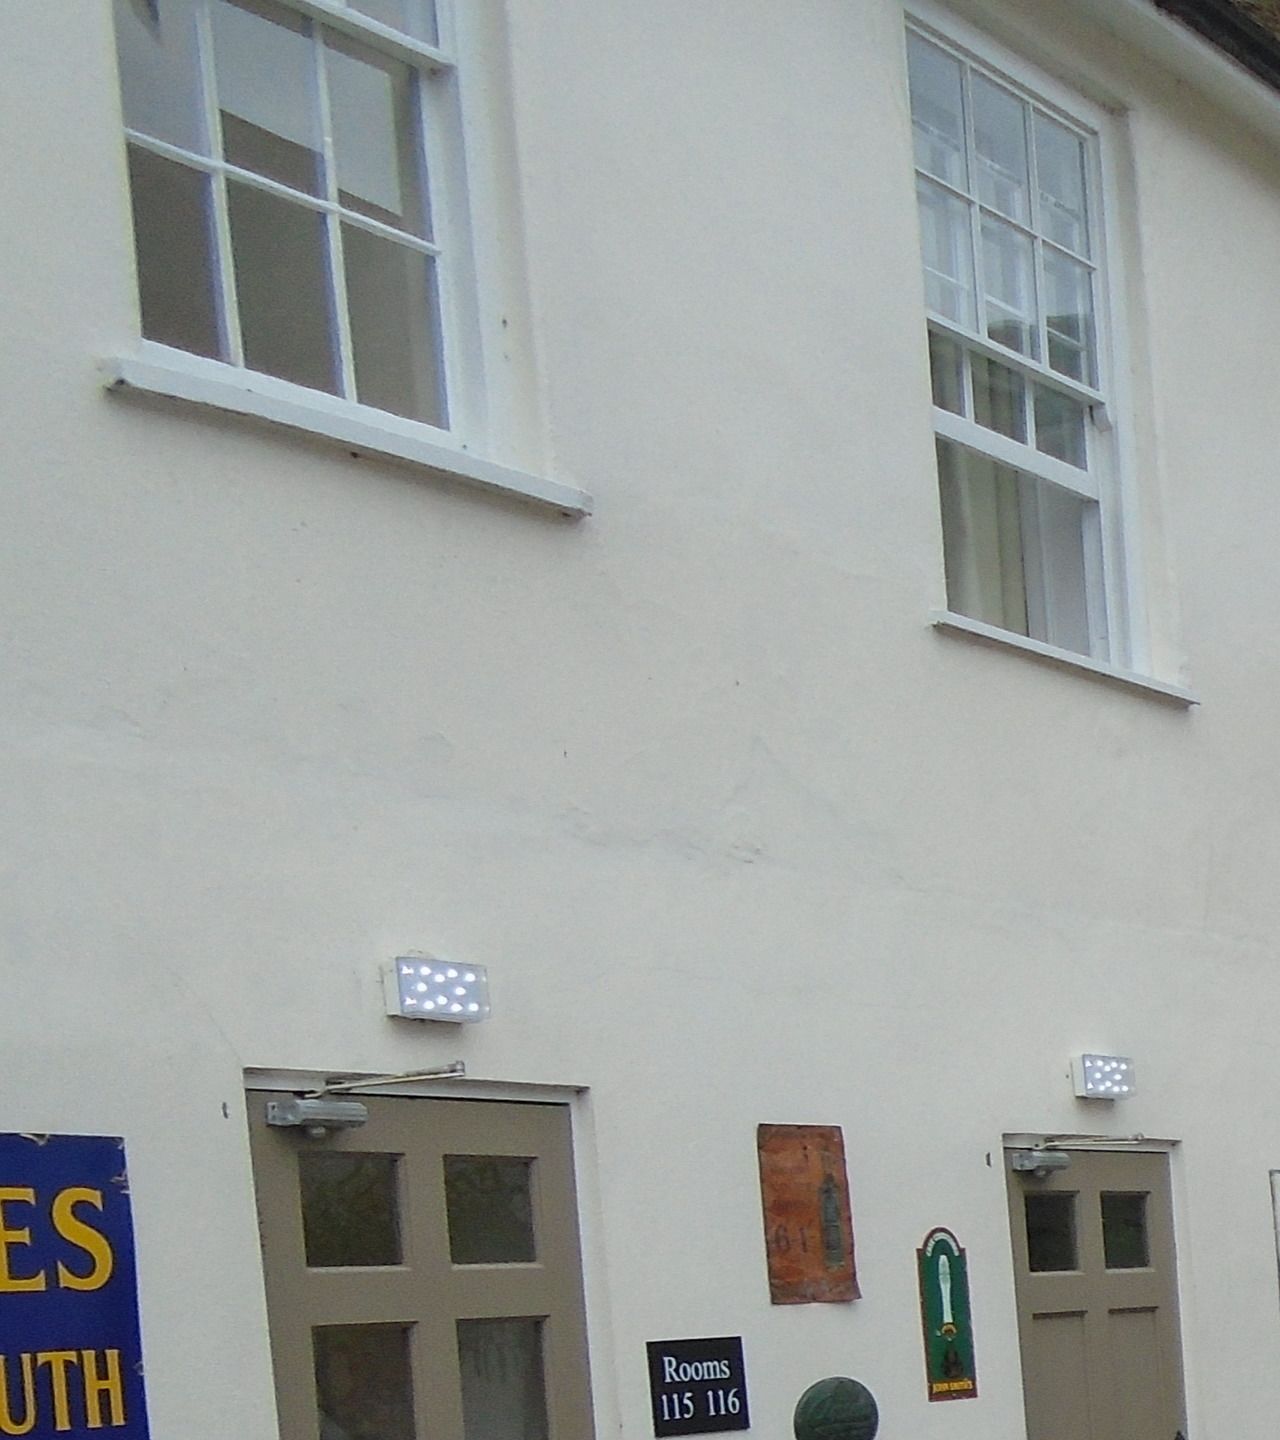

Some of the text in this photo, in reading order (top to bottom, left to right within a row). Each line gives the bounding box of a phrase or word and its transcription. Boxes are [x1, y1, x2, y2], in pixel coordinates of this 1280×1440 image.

[0, 1186, 114, 1292] ES
[0, 1349, 127, 1435] UTH
[662, 1356, 731, 1382] Rooms
[661, 1388, 740, 1420] 115 116
